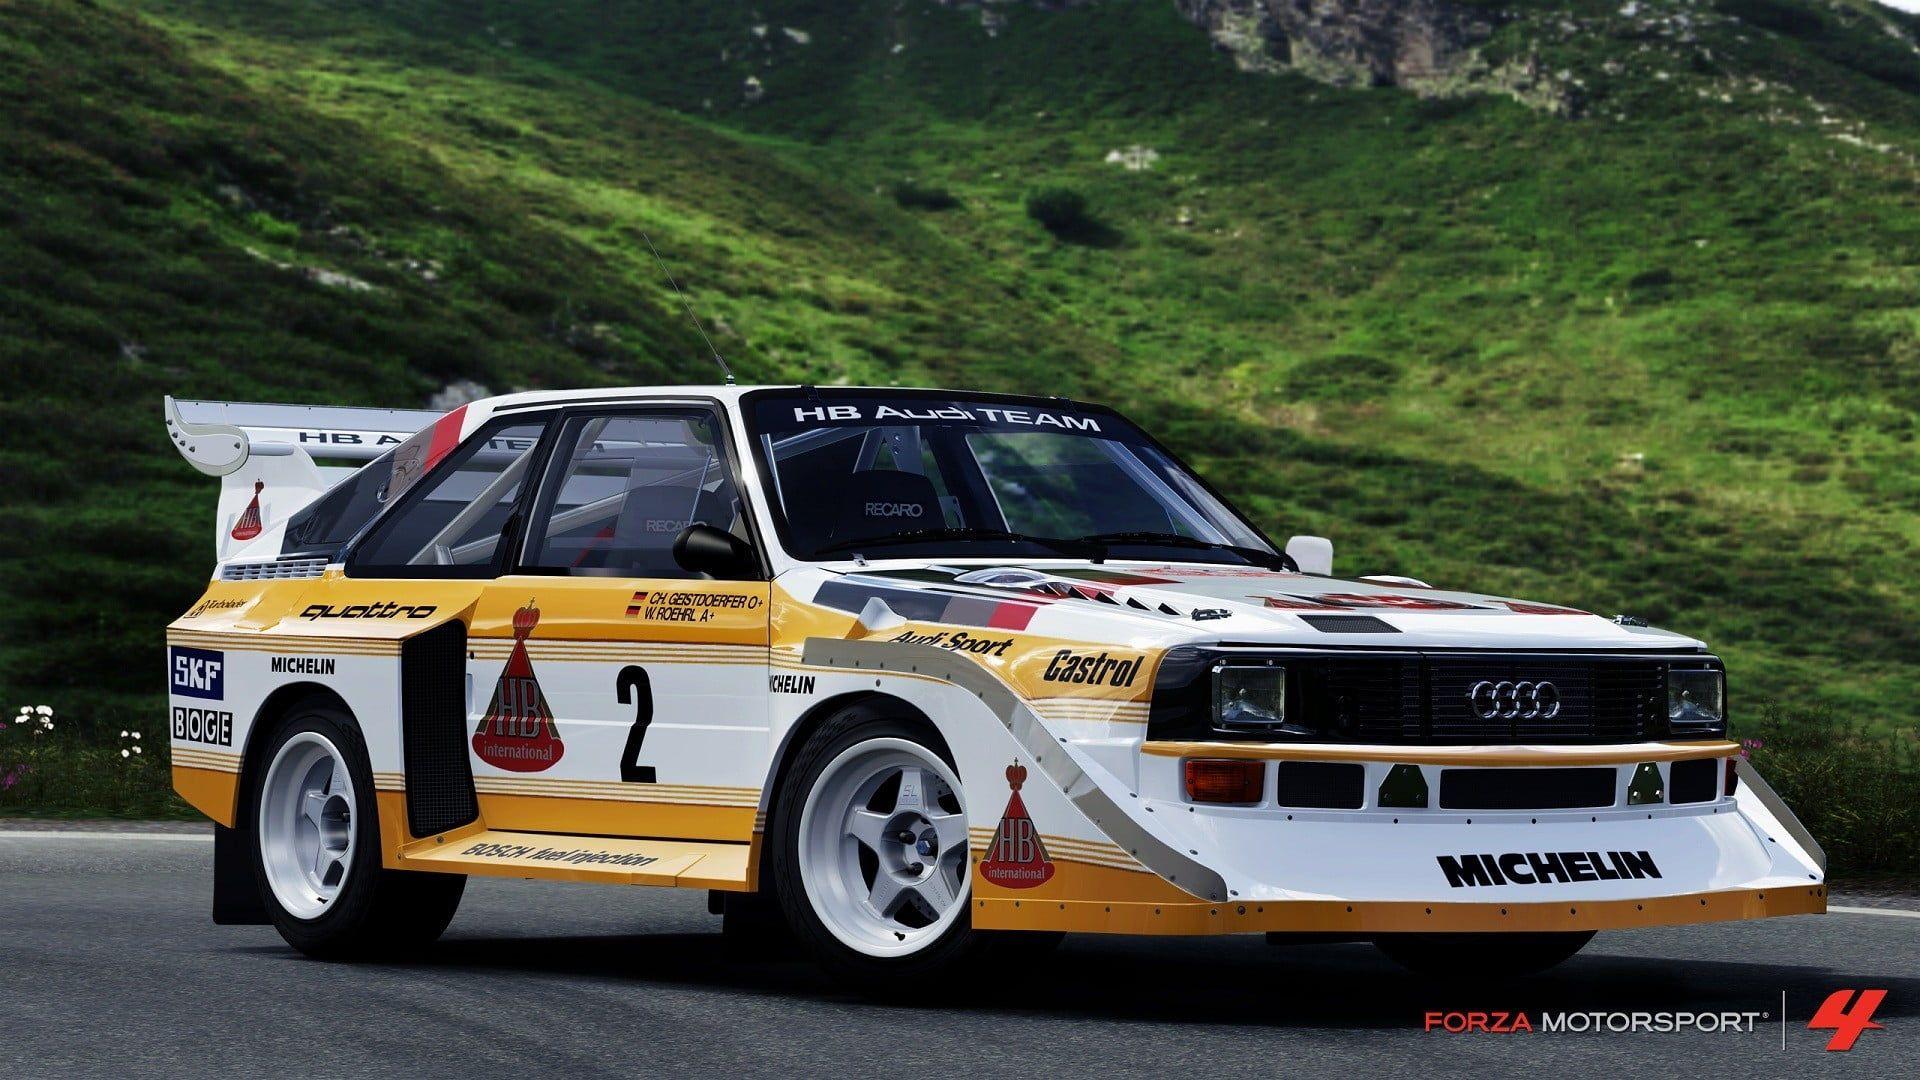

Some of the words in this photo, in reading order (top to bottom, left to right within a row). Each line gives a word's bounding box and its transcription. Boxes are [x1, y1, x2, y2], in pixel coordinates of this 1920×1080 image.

[793, 405, 861, 422] HB
[976, 408, 1101, 432] TEAM
[299, 431, 363, 444] HB
[865, 502, 923, 518] RECARO
[300, 601, 438, 621] quattro
[668, 592, 748, 609] GEISTDOERFER
[655, 607, 697, 622] ROEHRL
[941, 631, 1015, 656] Sport
[174, 655, 221, 691] SKF
[271, 657, 336, 675] MICHELIN
[1043, 649, 1145, 687] Castrol
[769, 674, 815, 694] ICHELIN
[496, 678, 542, 738] HB
[175, 709, 231, 744] BOGE
[616, 665, 657, 784] 2
[483, 741, 553, 762] international
[461, 843, 536, 858] BOSCH
[998, 818, 1035, 863] HB
[988, 866, 1045, 880] international
[1436, 850, 1663, 888] MICHELIN
